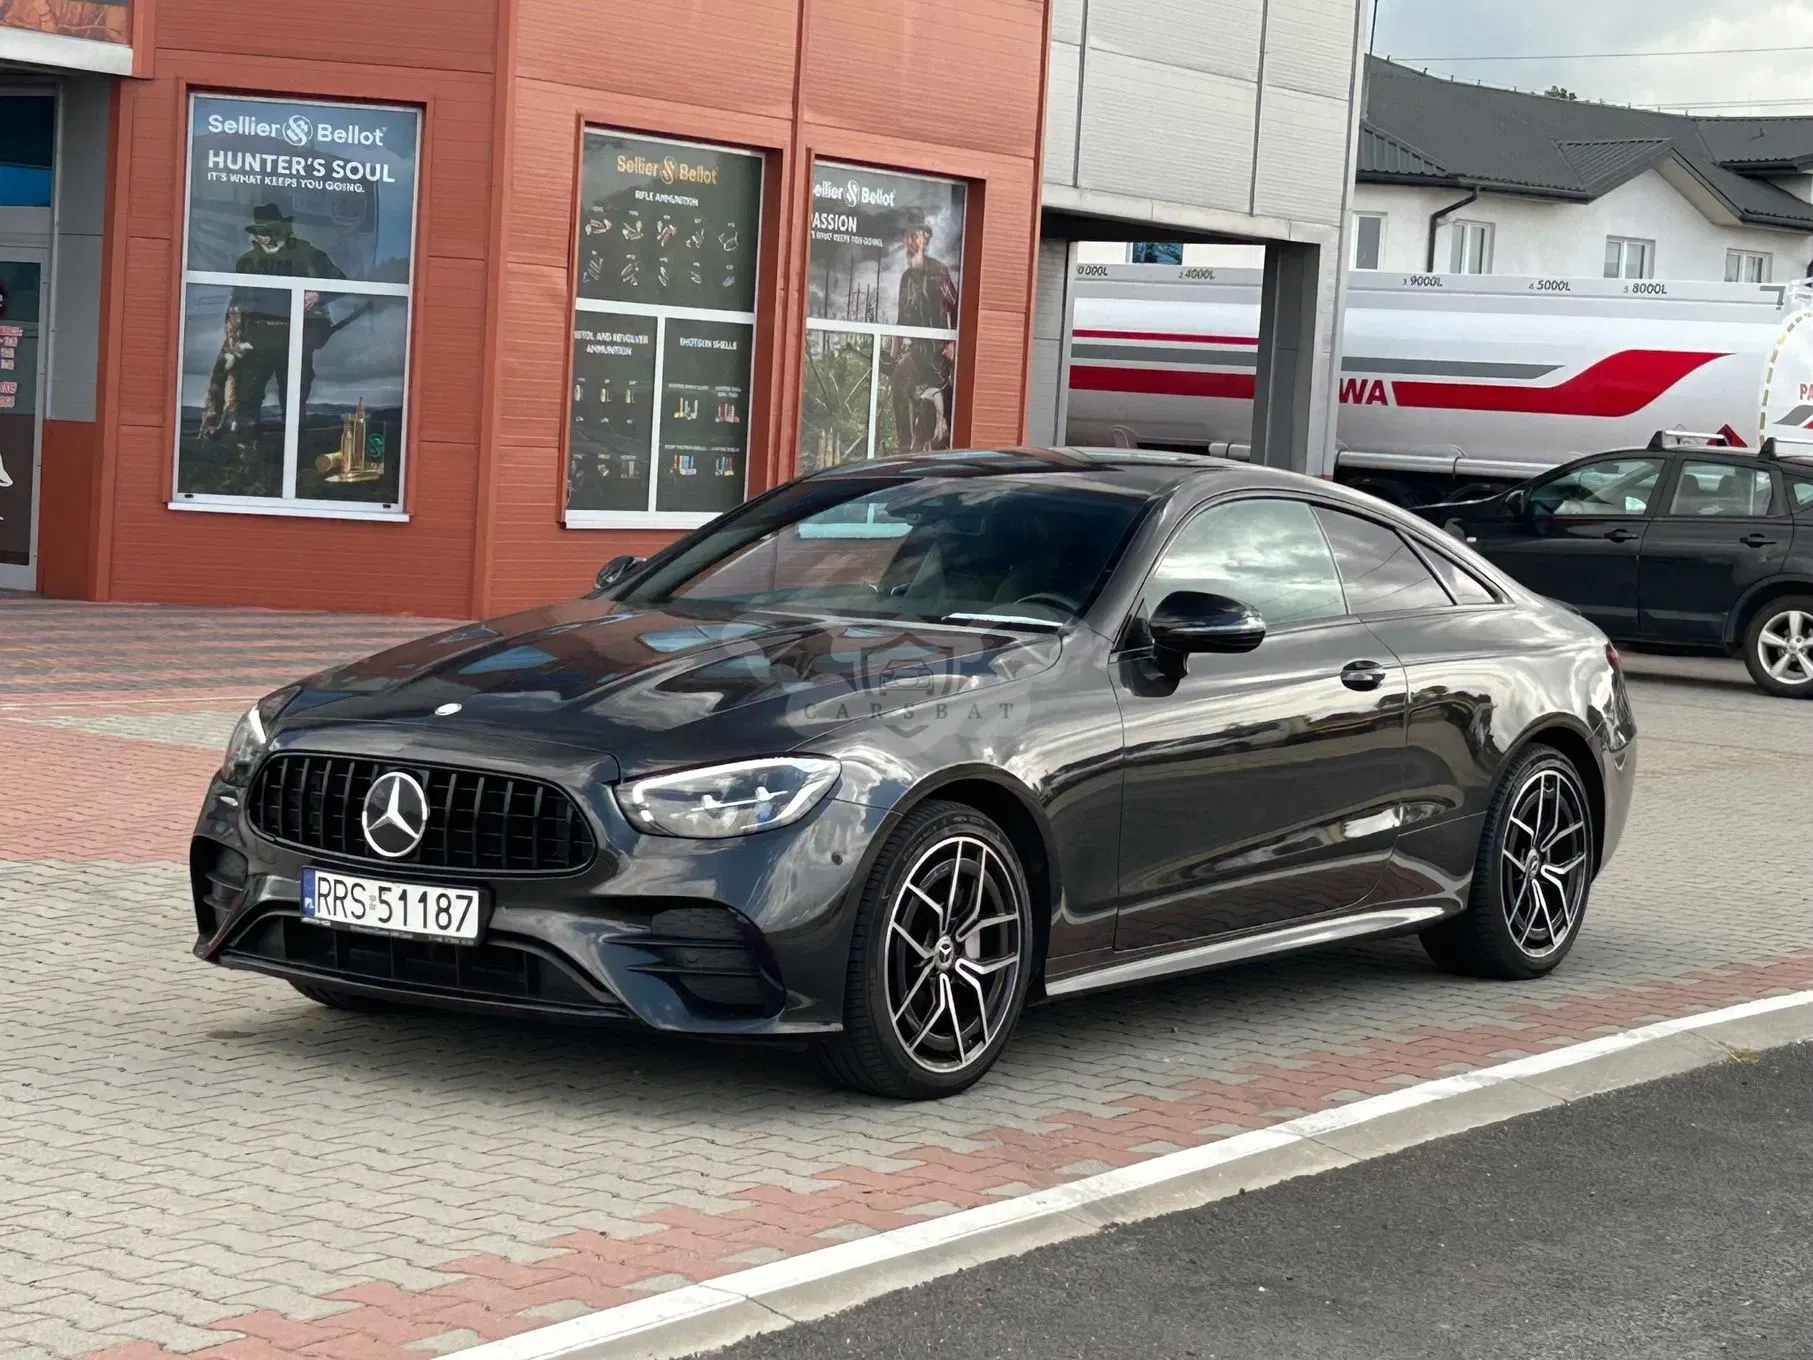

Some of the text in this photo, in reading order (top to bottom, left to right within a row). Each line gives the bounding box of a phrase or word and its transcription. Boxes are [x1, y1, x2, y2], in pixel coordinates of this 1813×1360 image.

[208, 114, 384, 147] Sellier Bellot
[208, 150, 395, 183] HUNTER'S SOUL
[617, 155, 717, 185] Sellier Bellot
[207, 172, 227, 182] IT'S
[229, 173, 262, 185] WHAT
[264, 176, 297, 188] KEEPS
[299, 179, 323, 190] YOU
[813, 180, 895, 207] ellier Bellot
[811, 212, 857, 233] ASSION
[1410, 274, 1443, 287] 9000L
[1536, 279, 1571, 291] 5000L
[1632, 282, 1667, 294] 8000L
[317, 876, 474, 933] RRS 51187
